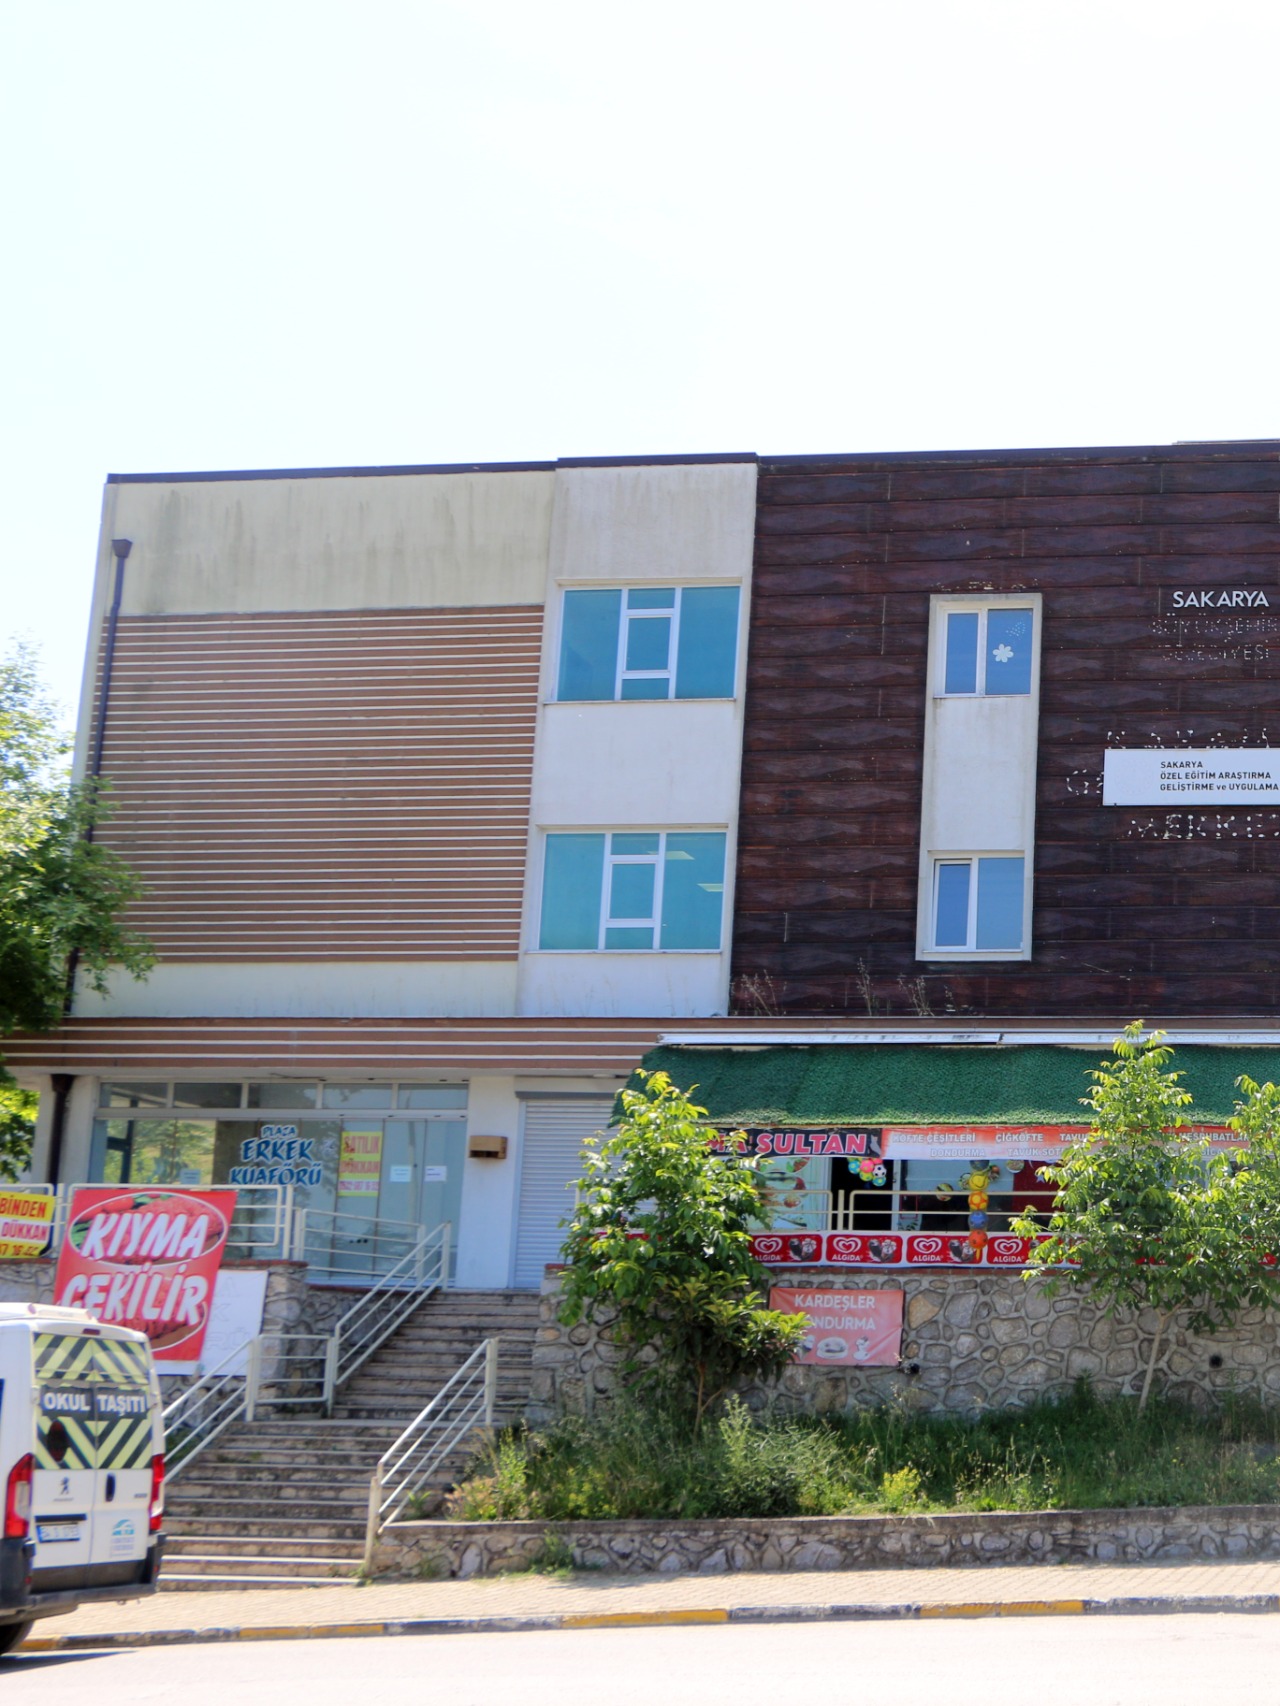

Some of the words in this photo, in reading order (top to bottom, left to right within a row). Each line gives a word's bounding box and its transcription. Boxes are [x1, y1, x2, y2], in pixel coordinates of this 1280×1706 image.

[1172, 590, 1270, 608] SAKARYA
[1160, 760, 1204, 769] SAKARYA
[1160, 771, 1183, 780] ÖZEL
[1184, 771, 1216, 779] EĞİTİM
[1218, 771, 1271, 781] ARAŞTIRMA
[1160, 782, 1215, 792] GELİŞTİRME
[1228, 782, 1279, 791] UYGULAMA
[261, 1125, 297, 1139] PLAZA
[241, 1138, 314, 1163] ERKEK
[755, 1133, 868, 1155] SULTAN
[930, 1148, 987, 1158] DONDURMA
[1007, 1148, 1038, 1157] TAVUK
[229, 1162, 323, 1186] KUAFÖRÜ
[1, 1219, 50, 1241] DÜKKAN
[80, 1212, 210, 1260] KIYMA
[794, 1294, 876, 1312] KARDEŞLER
[804, 1315, 876, 1330] ONDURMA
[42, 1392, 91, 1411] OKUL
[97, 1393, 148, 1417] TAŞITI
